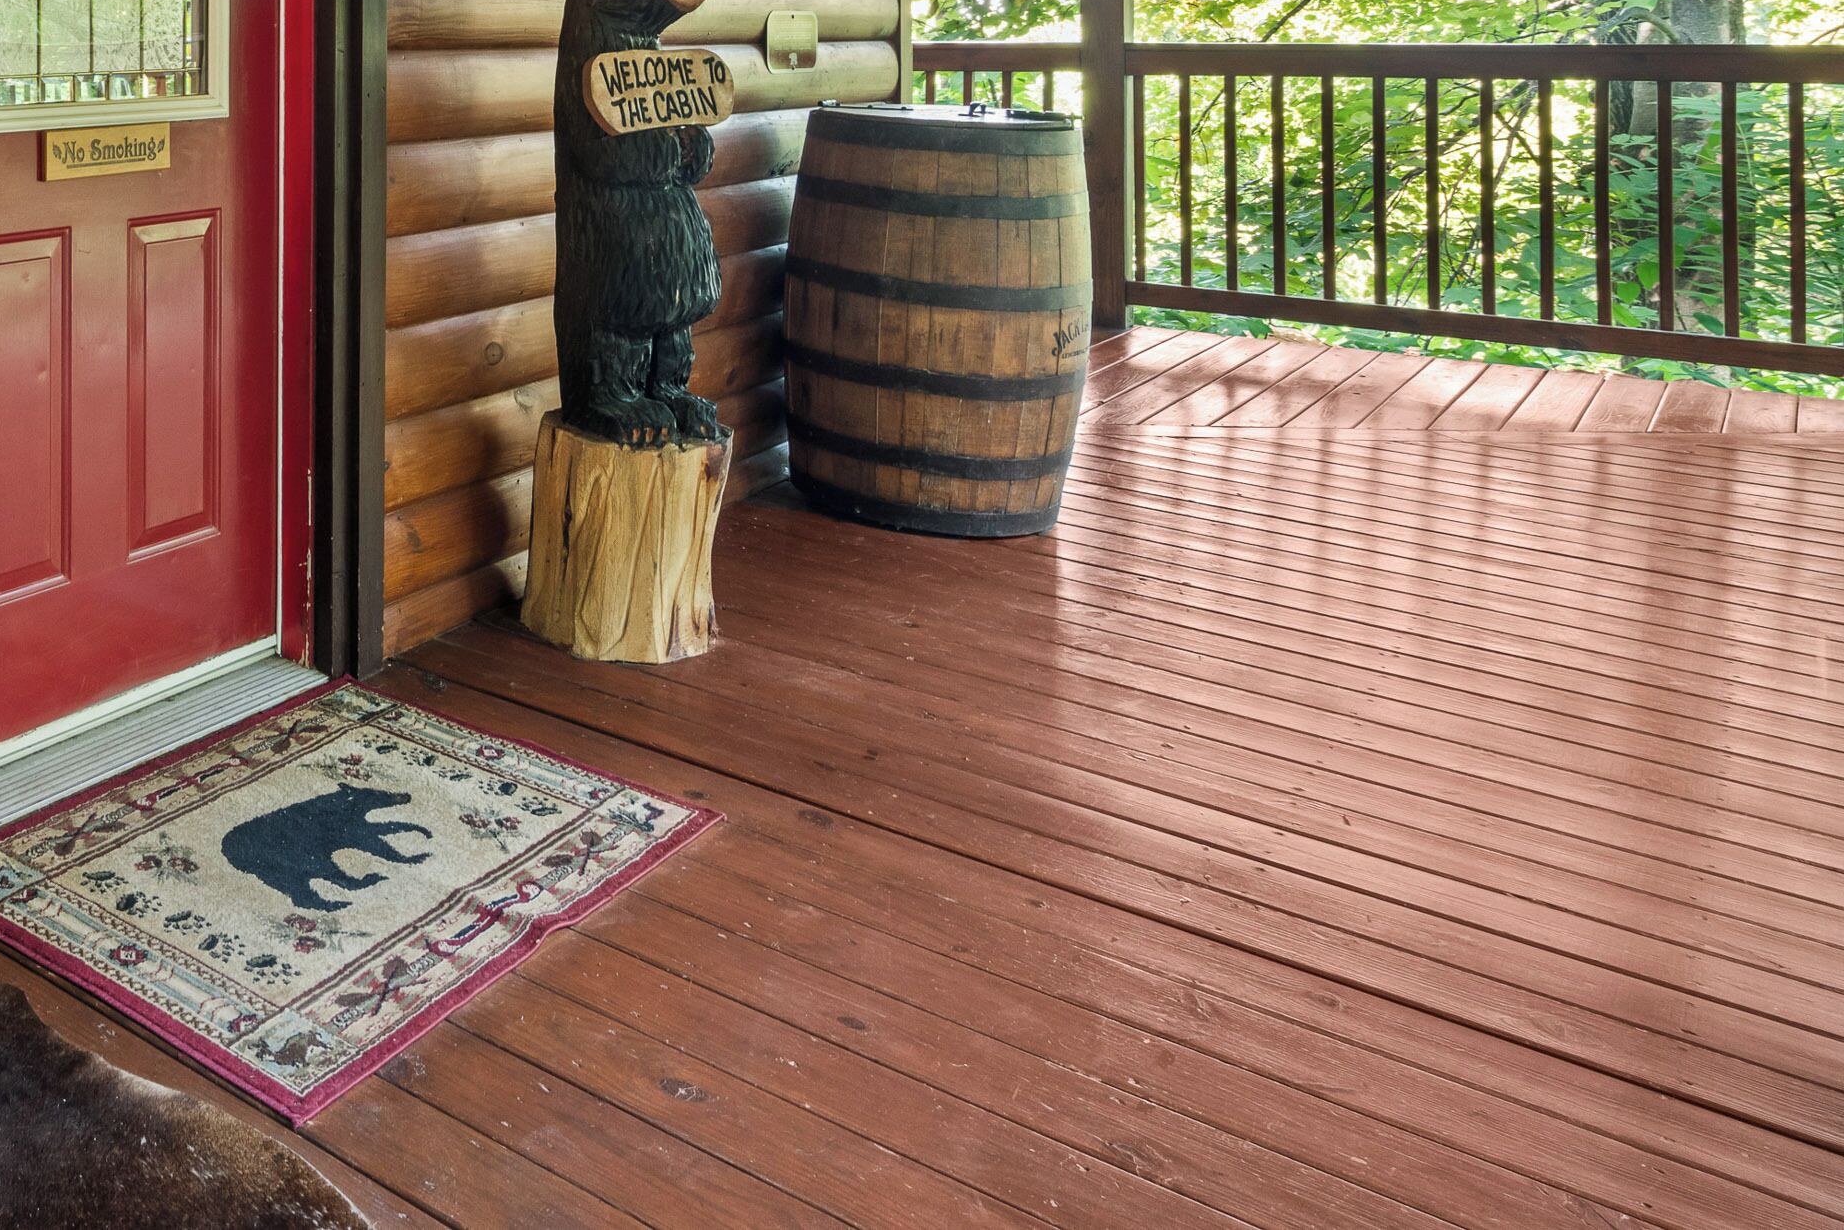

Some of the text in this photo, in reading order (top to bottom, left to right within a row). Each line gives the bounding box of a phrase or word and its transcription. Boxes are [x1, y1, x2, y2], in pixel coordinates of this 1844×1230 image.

[599, 55, 726, 97] WELCOME TO
[610, 87, 719, 128] THE CABIN
[62, 136, 157, 164] No Smoking
